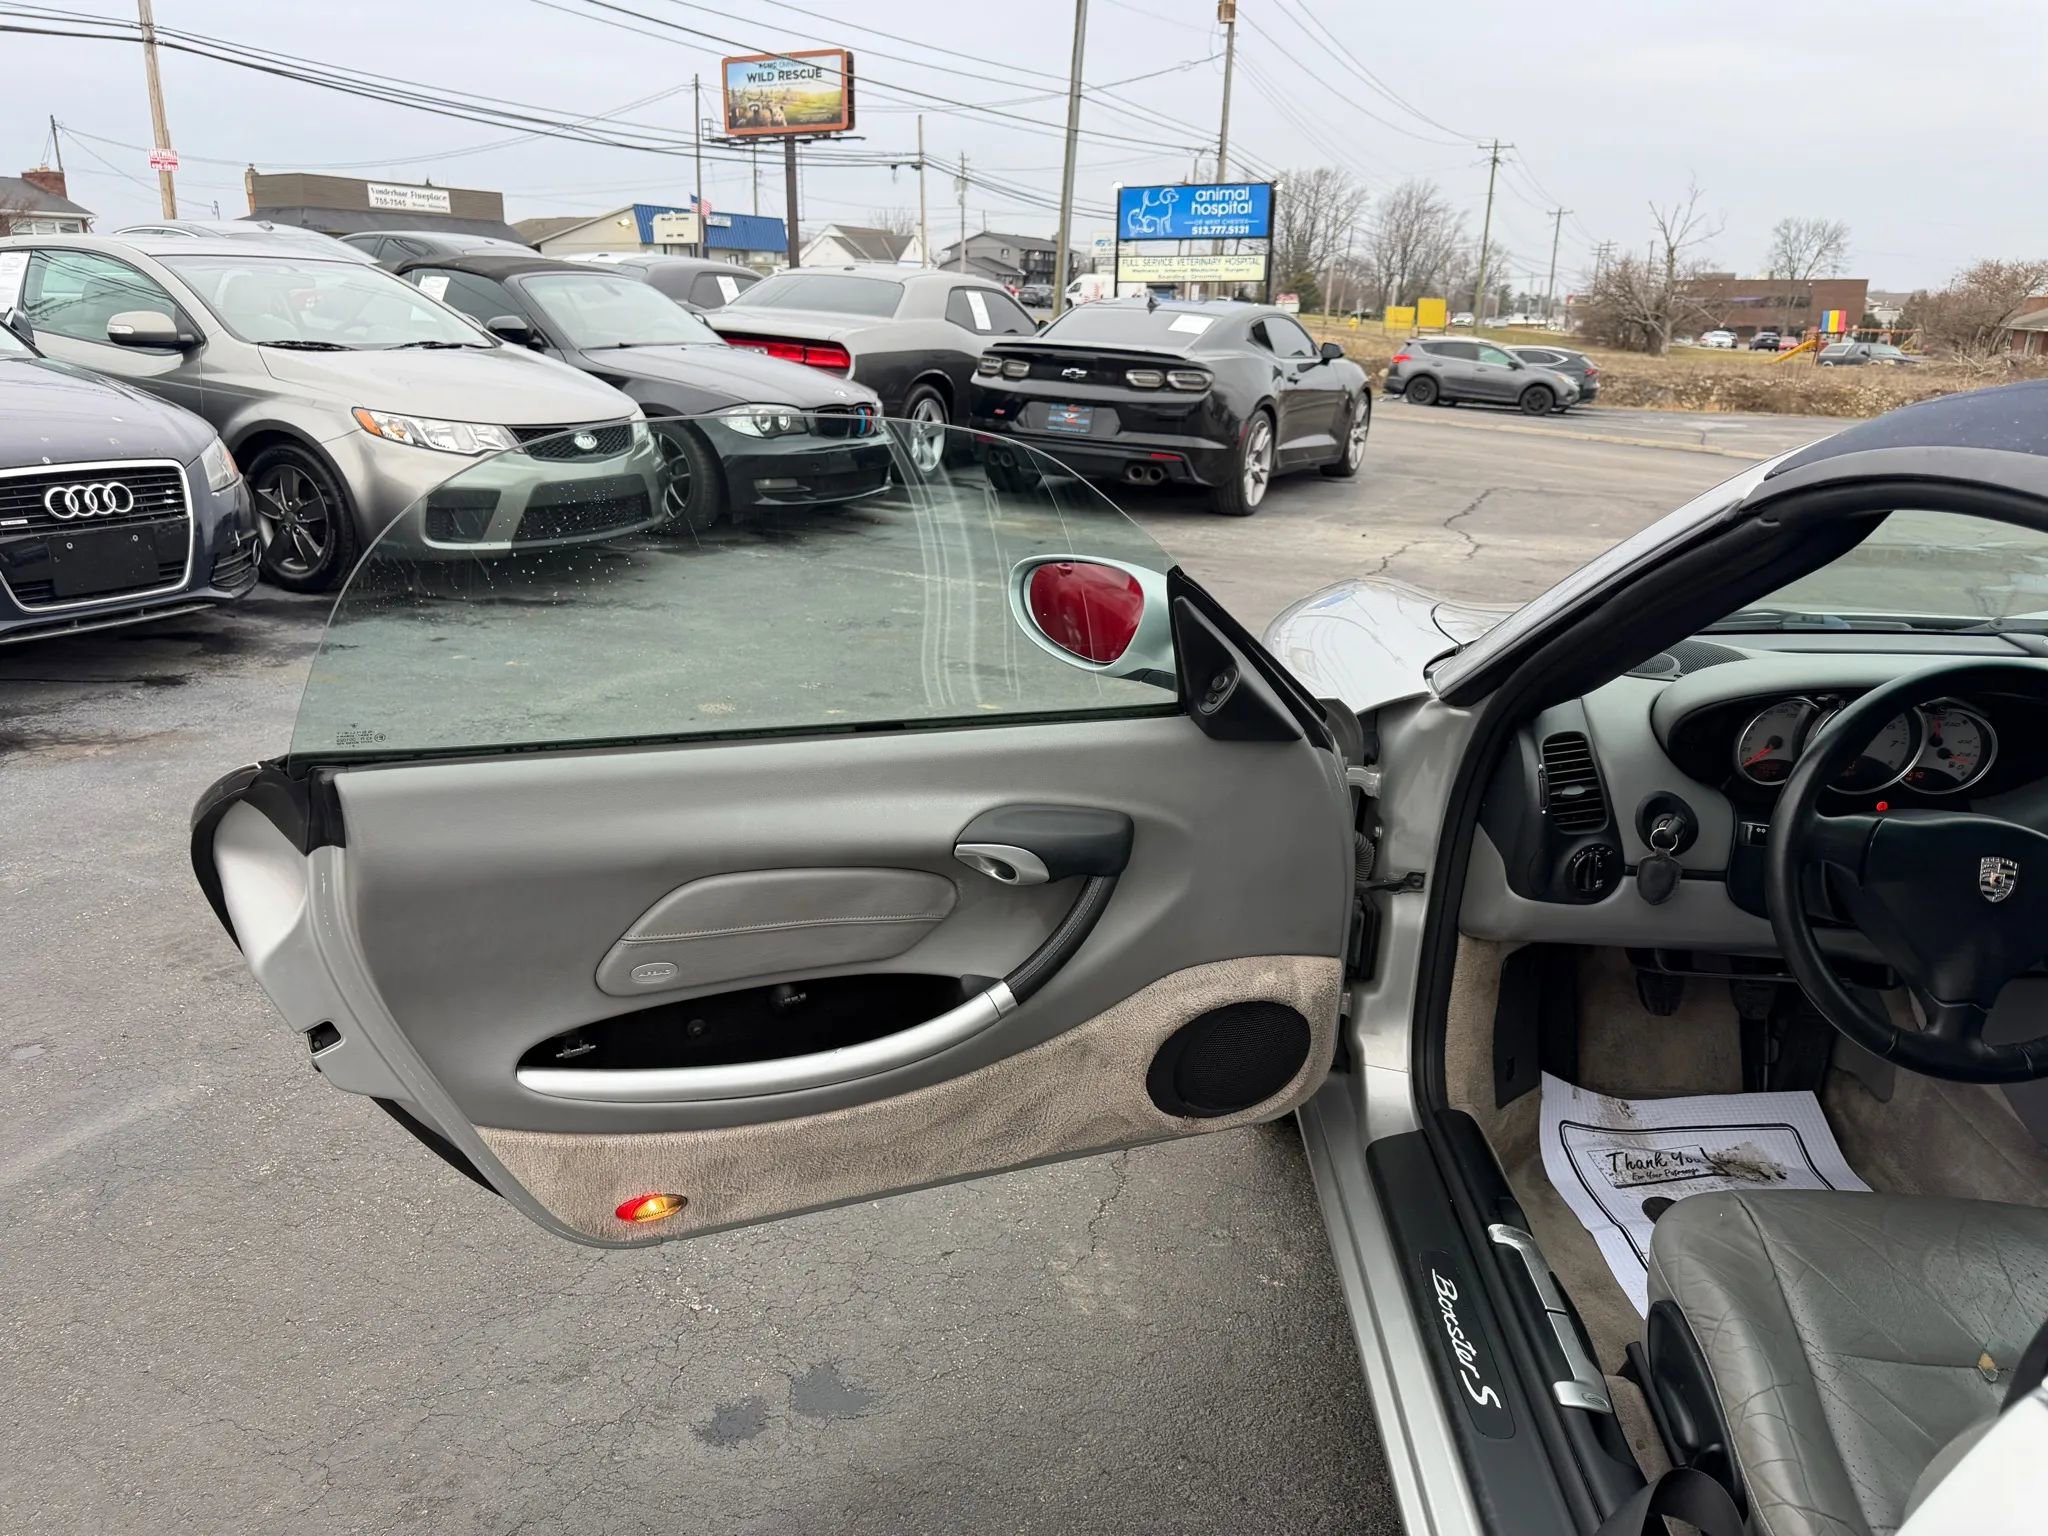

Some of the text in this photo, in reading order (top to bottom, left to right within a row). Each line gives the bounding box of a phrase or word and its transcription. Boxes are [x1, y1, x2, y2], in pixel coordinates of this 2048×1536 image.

[746, 68, 823, 83] WILD RESCUE
[410, 190, 448, 202] Fireplace
[1195, 186, 1250, 202] animal
[1191, 200, 1253, 217] hospital
[1191, 225, 1249, 235] 513.777.5131
[1122, 257, 1261, 267] FULL SERVICE VETERINARY HOSPITAL
[1605, 1151, 1668, 1173] Thank
[1431, 1267, 1502, 1409] Boxster S
